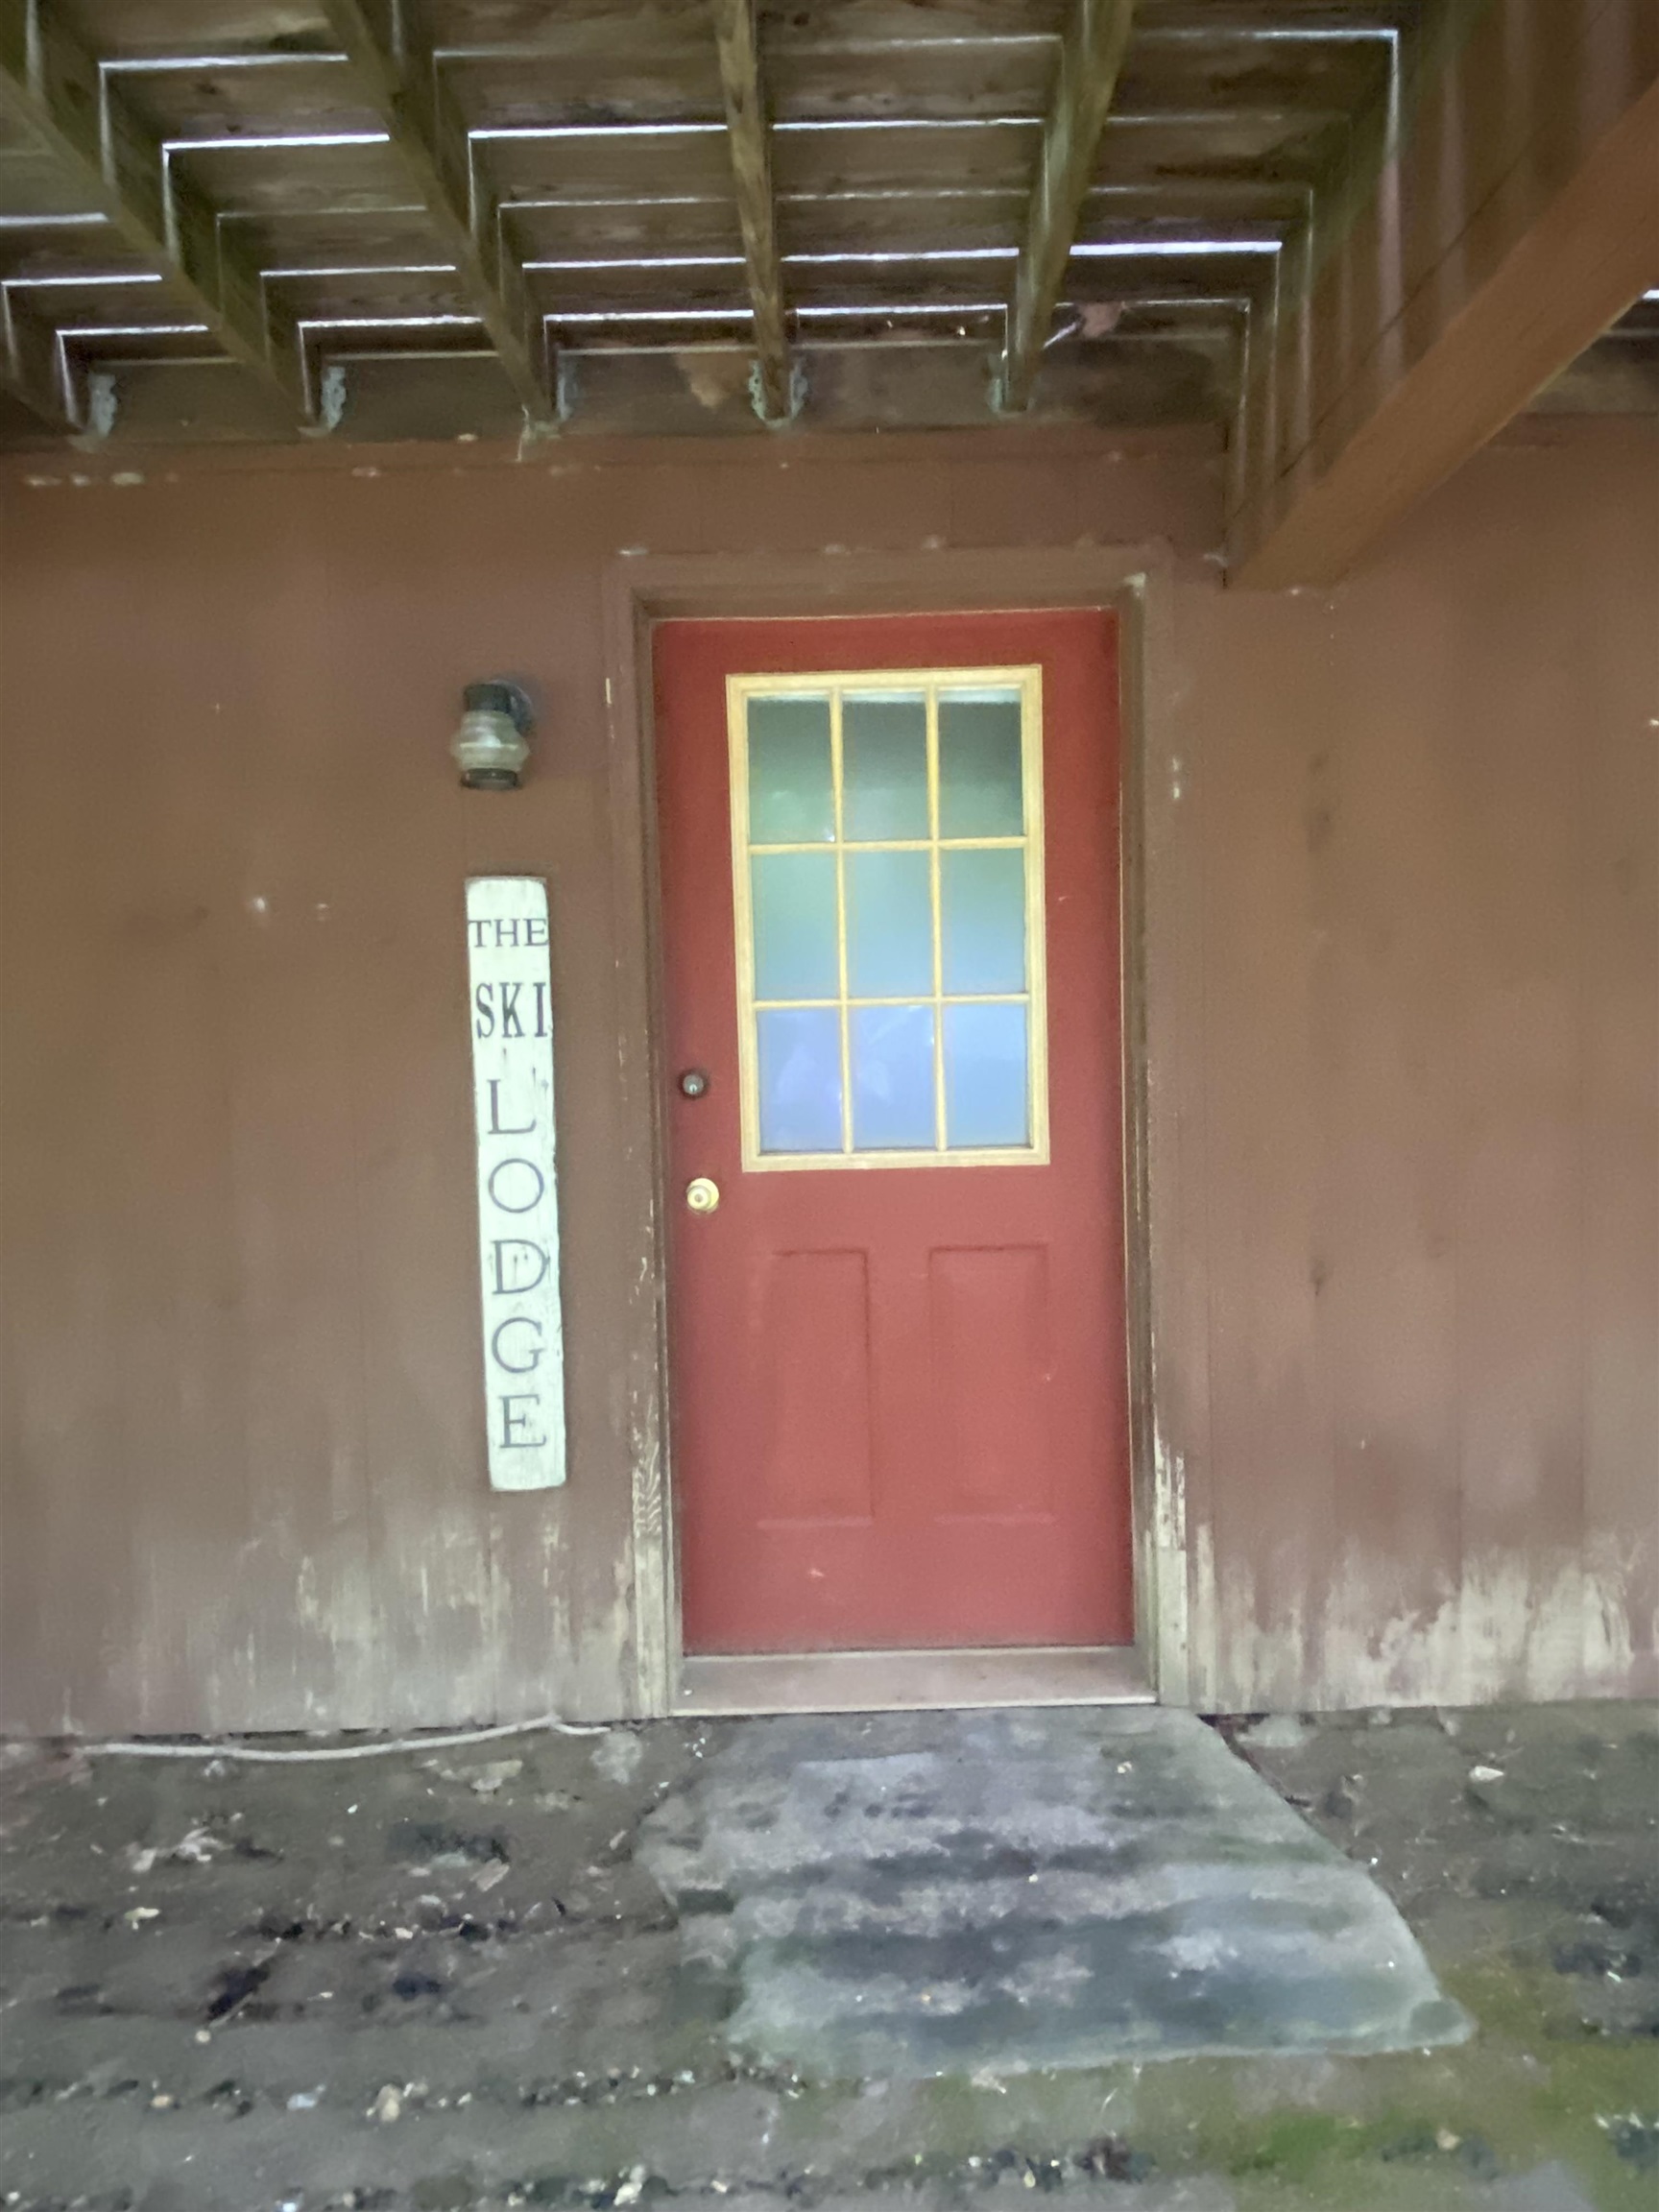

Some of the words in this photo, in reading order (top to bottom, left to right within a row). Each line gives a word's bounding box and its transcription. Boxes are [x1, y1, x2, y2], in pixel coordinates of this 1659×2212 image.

[468, 918, 549, 948] THE
[475, 981, 548, 1039] SKI
[486, 1078, 550, 1449] LODGE
